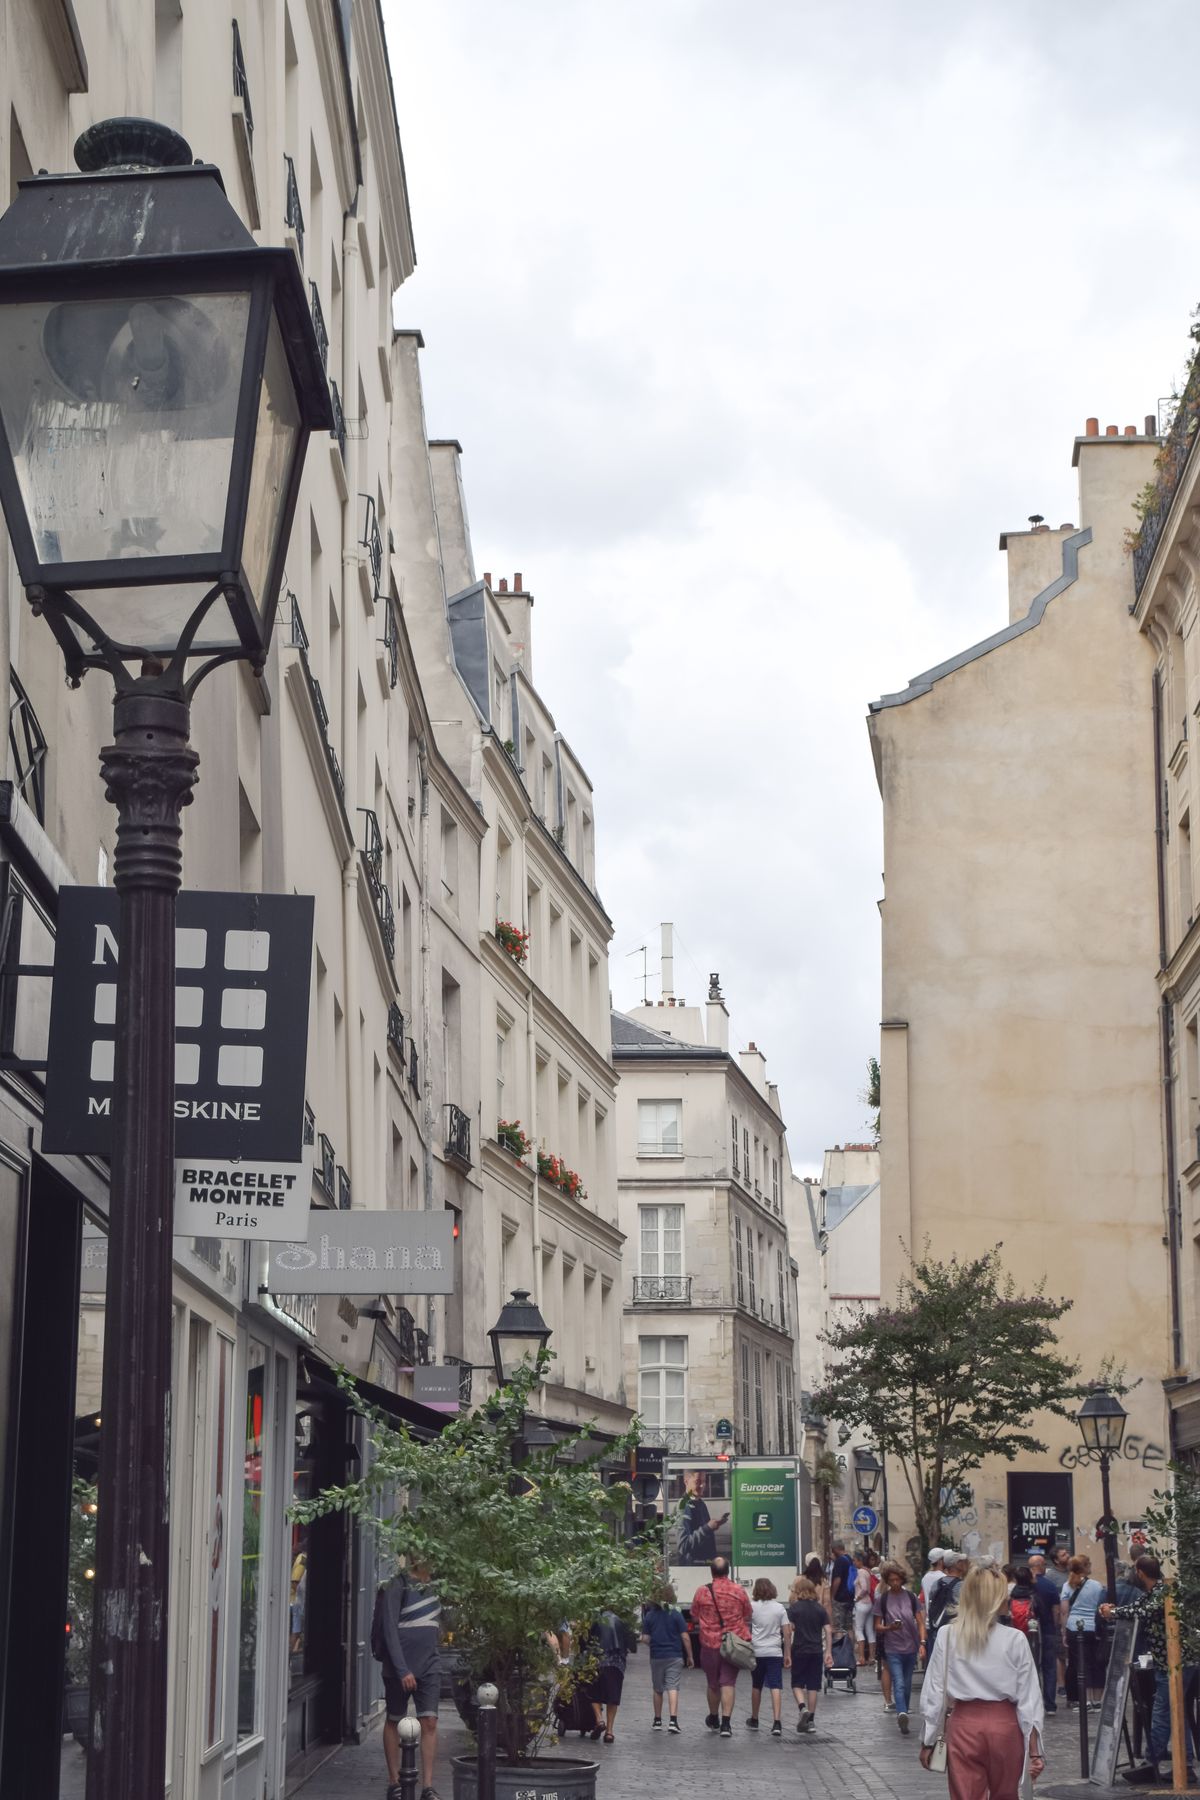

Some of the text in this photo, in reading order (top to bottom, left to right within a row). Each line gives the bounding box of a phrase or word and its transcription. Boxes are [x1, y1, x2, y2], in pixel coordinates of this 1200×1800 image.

[88, 1096, 261, 1121] MSKINE
[182, 1169, 297, 1190] BRACELET
[190, 1188, 286, 1208] MONTRE
[215, 1211, 259, 1228] Paris
[740, 1483, 785, 1494] Europcar
[757, 1514, 769, 1526] E
[1022, 1506, 1057, 1520] VENTE
